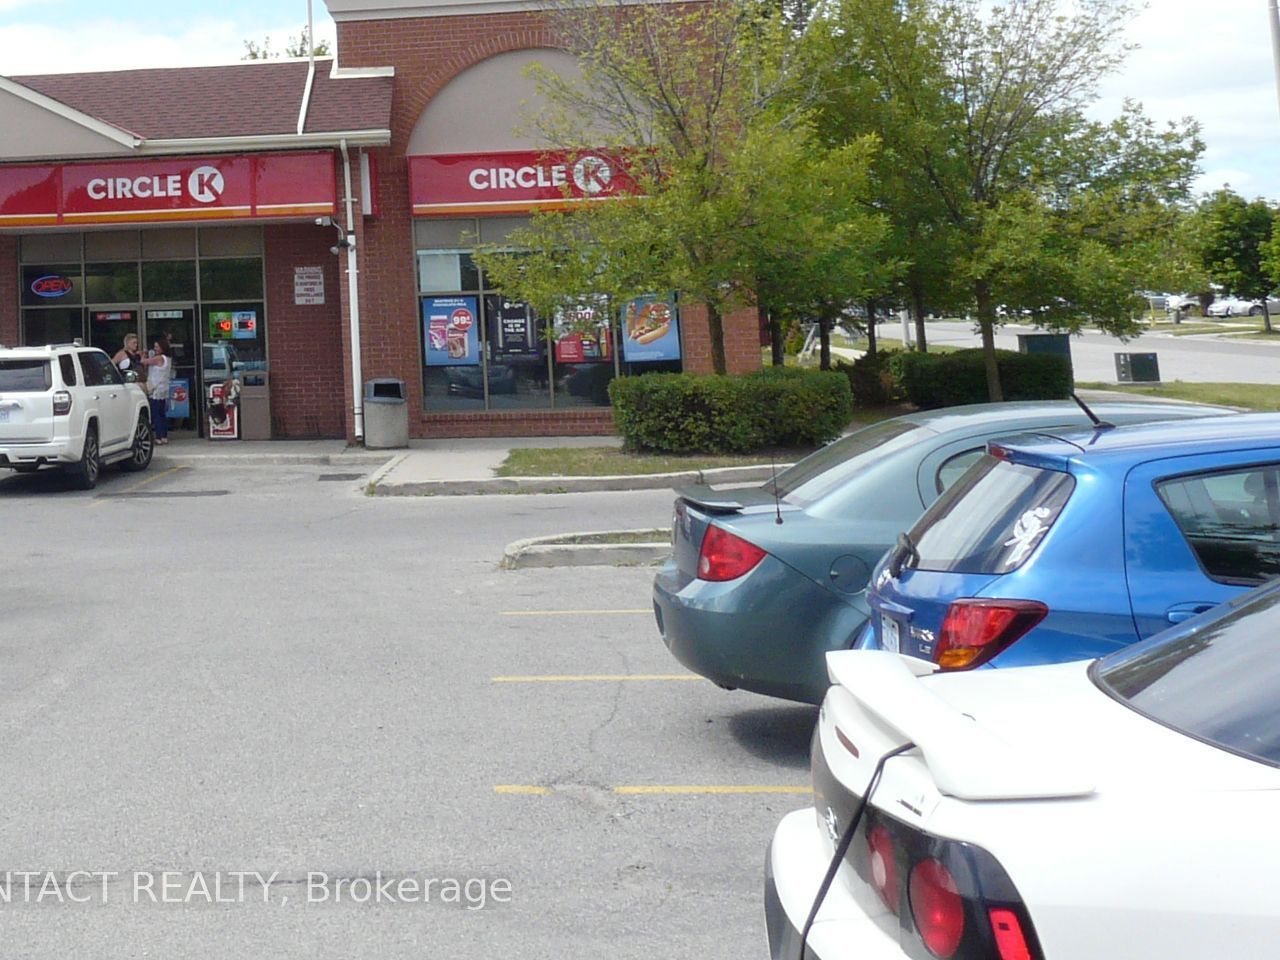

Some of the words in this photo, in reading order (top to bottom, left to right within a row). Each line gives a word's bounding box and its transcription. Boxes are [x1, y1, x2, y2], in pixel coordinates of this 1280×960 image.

[87, 175, 182, 200] CIRCLE
[194, 169, 224, 202] K
[469, 166, 566, 190] CIRCLE
[579, 158, 611, 193] K
